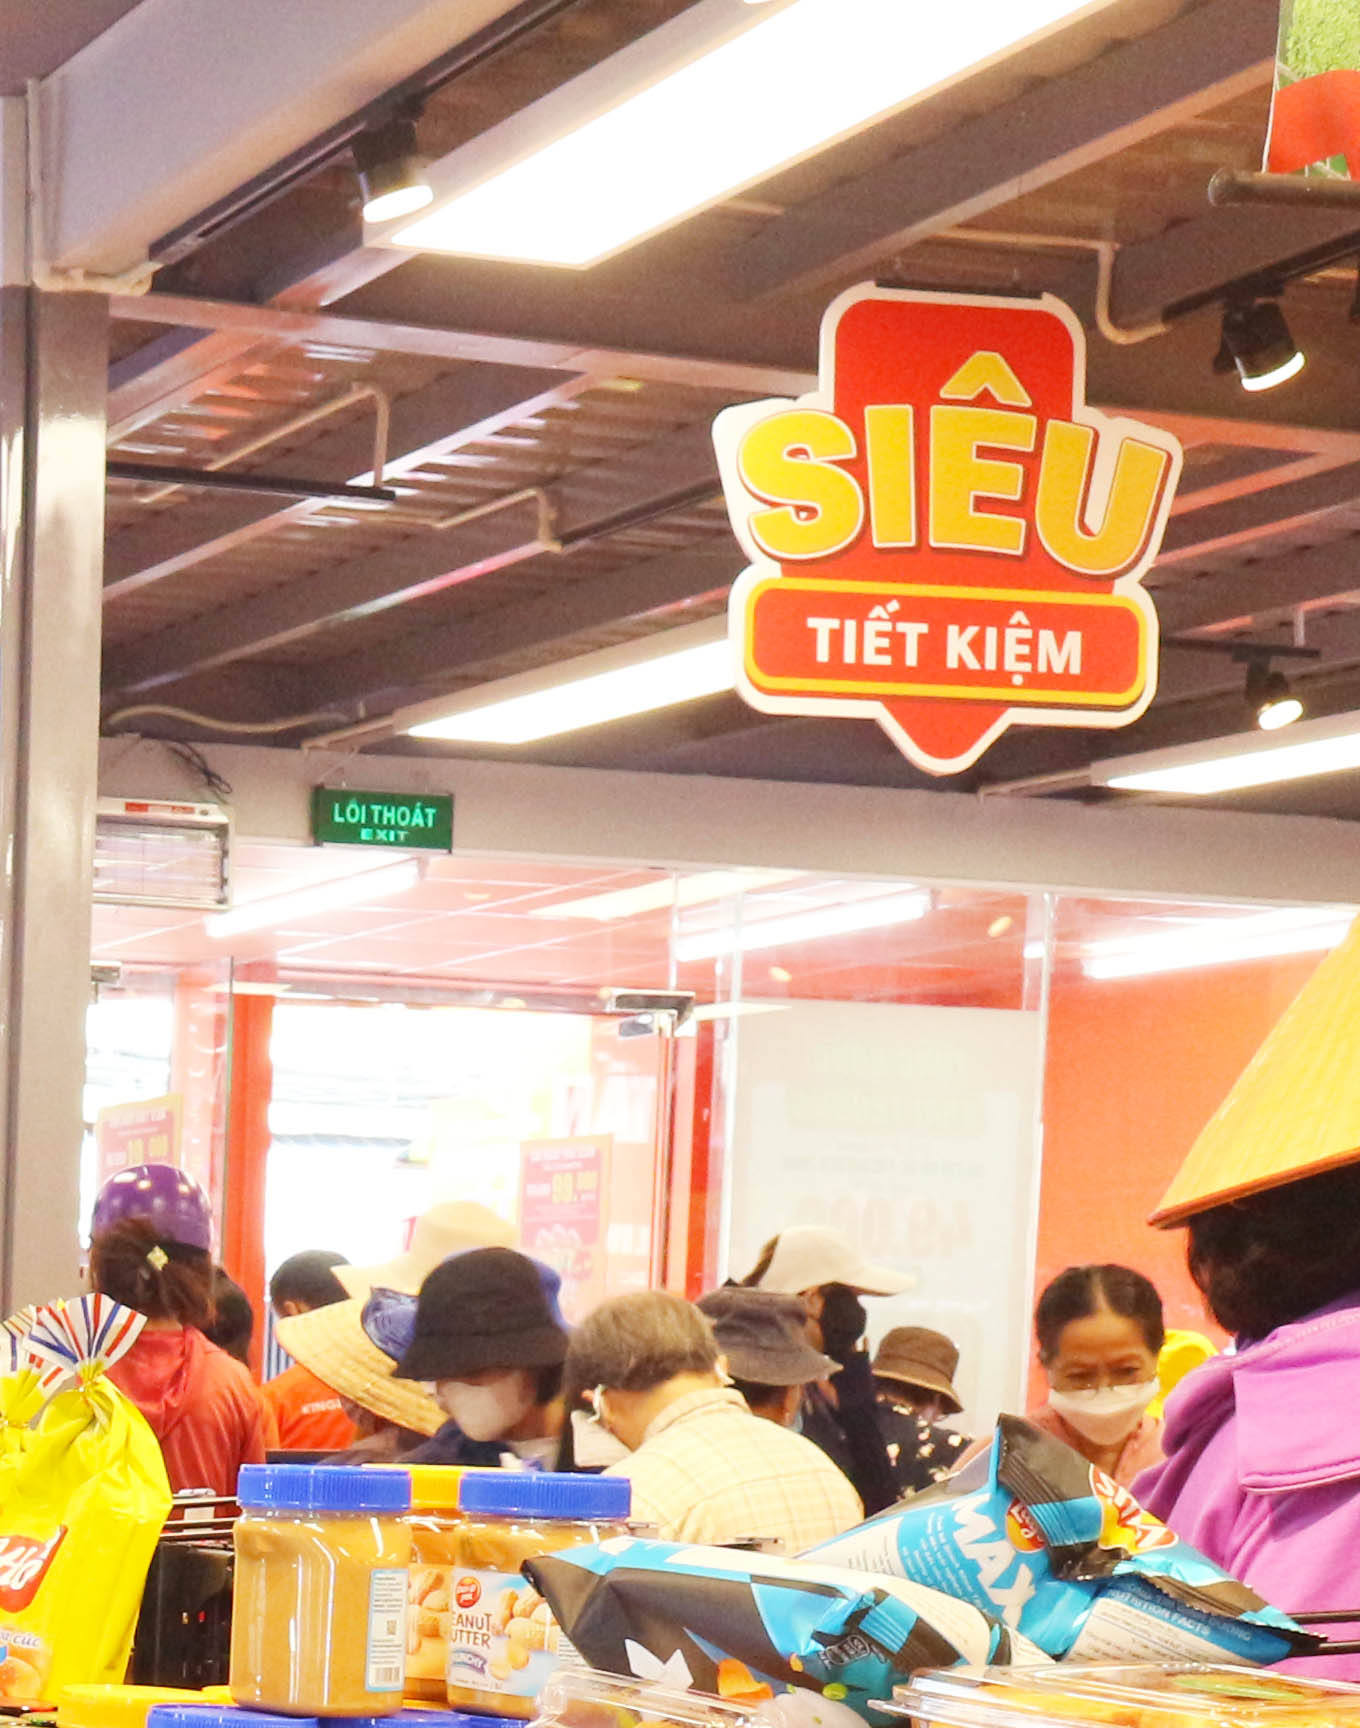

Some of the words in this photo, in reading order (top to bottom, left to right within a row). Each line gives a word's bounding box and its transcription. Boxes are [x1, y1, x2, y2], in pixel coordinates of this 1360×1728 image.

[737, 350, 1169, 576] SIÊU
[806, 599, 929, 667] TIẾT
[945, 610, 1083, 686] KIỆM
[360, 828, 409, 842] EXIT
[371, 801, 437, 829] THOÁT
[950, 1491, 1035, 1632] MAX
[451, 1631, 491, 1650] UTTER
